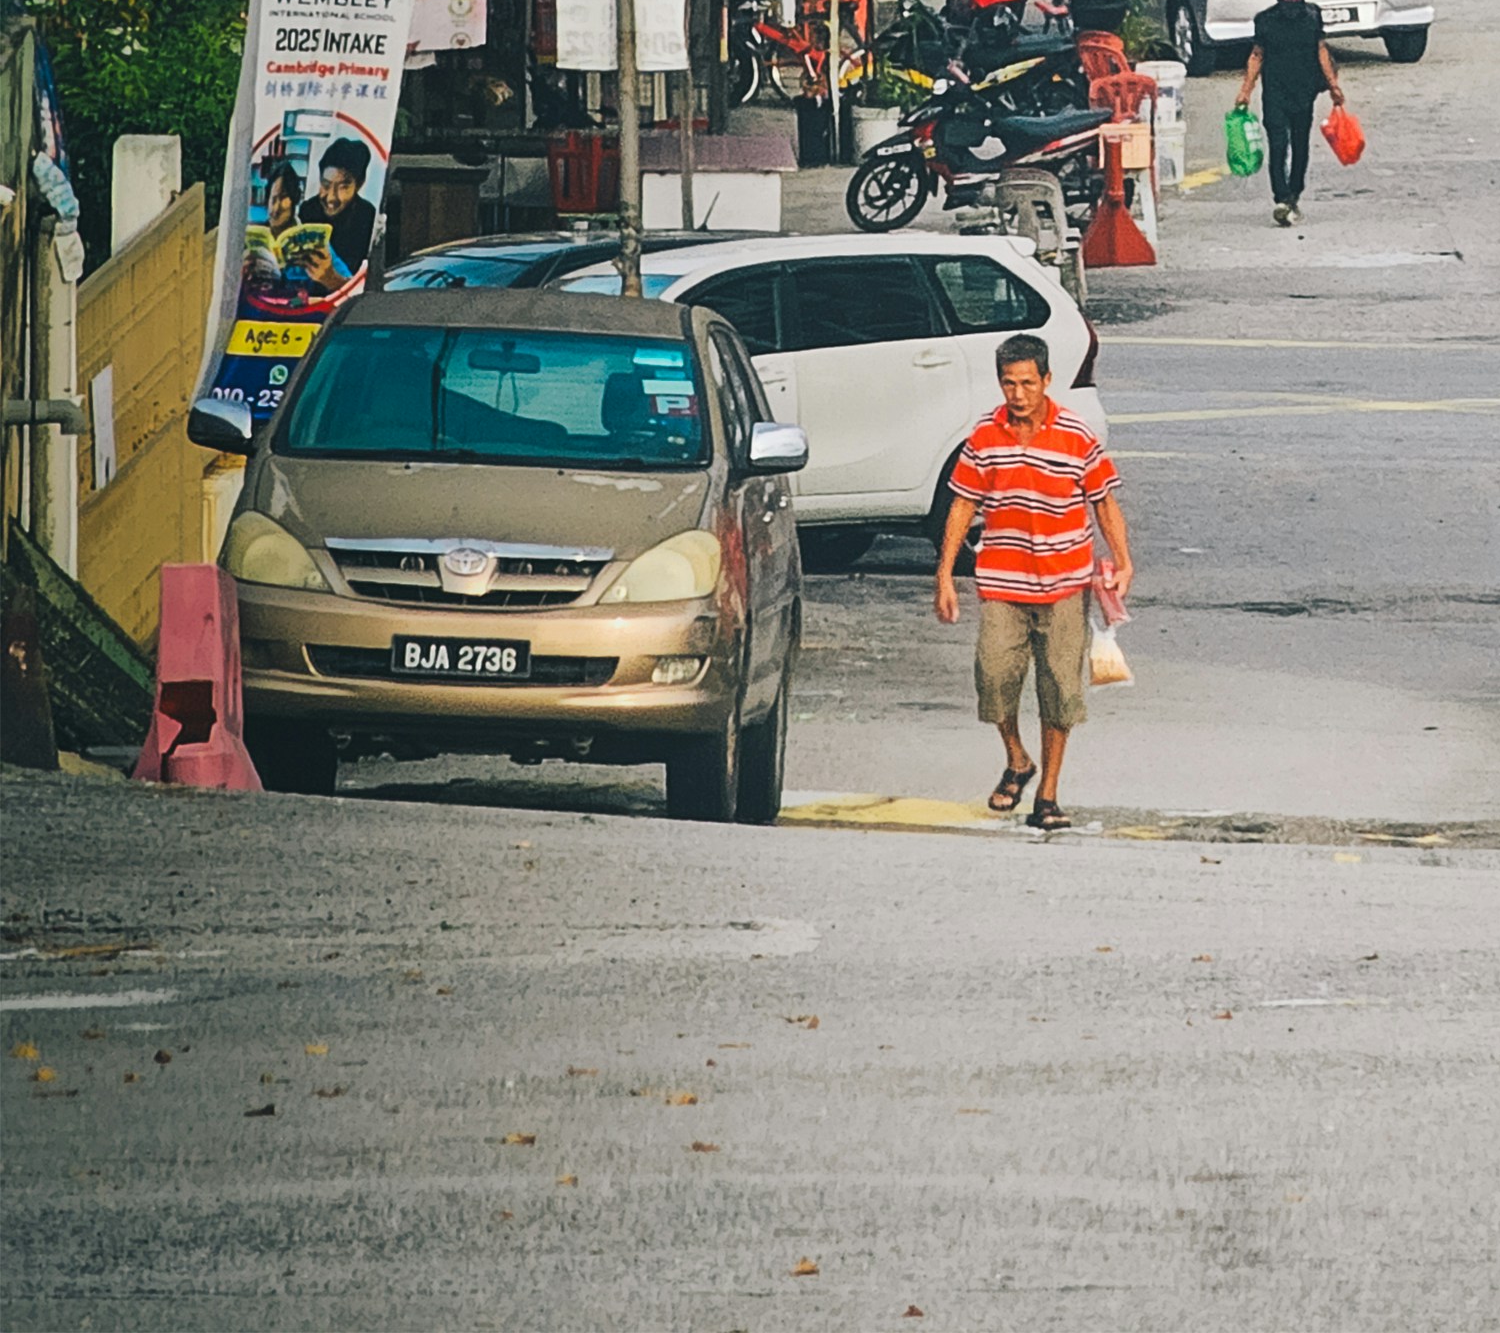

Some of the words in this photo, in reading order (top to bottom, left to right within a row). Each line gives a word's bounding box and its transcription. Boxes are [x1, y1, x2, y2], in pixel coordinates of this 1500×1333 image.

[269, 9, 351, 21] INTERNATIONAL
[353, 13, 397, 23] SCHOOL
[275, 27, 322, 53] 2025
[265, 60, 336, 79] Cambridge
[337, 61, 390, 81] Primary
[244, 328, 278, 353] Age:
[281, 328, 290, 345] 6
[404, 642, 450, 670] BJA
[457, 645, 517, 673] 2736
